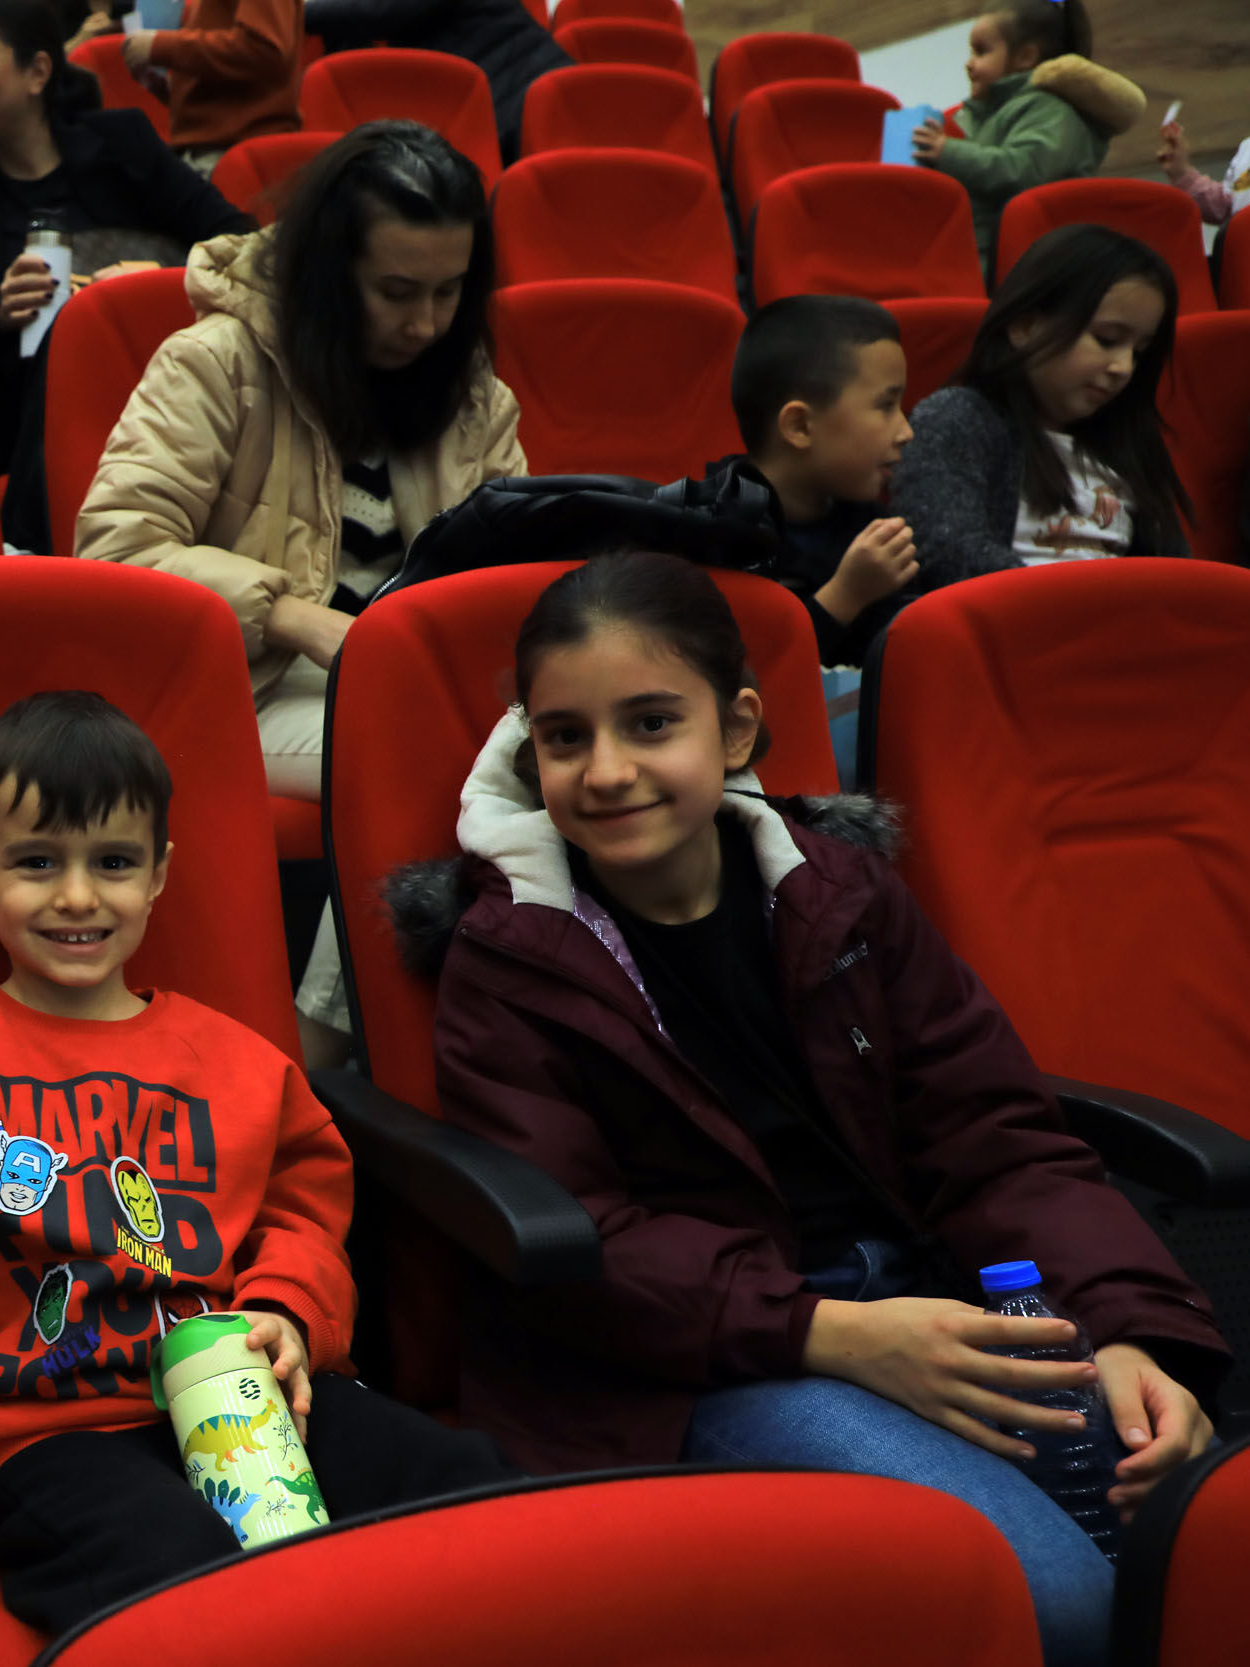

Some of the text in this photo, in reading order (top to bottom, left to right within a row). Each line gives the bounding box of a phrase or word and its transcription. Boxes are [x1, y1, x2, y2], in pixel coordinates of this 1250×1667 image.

[822, 940, 869, 980] oluma
[11, 1151, 42, 1174] A
[116, 1227, 144, 1264] IRON
[144, 1246, 173, 1279] MAN
[9, 1259, 210, 1352] YOU
[40, 1324, 102, 1380] HULK
